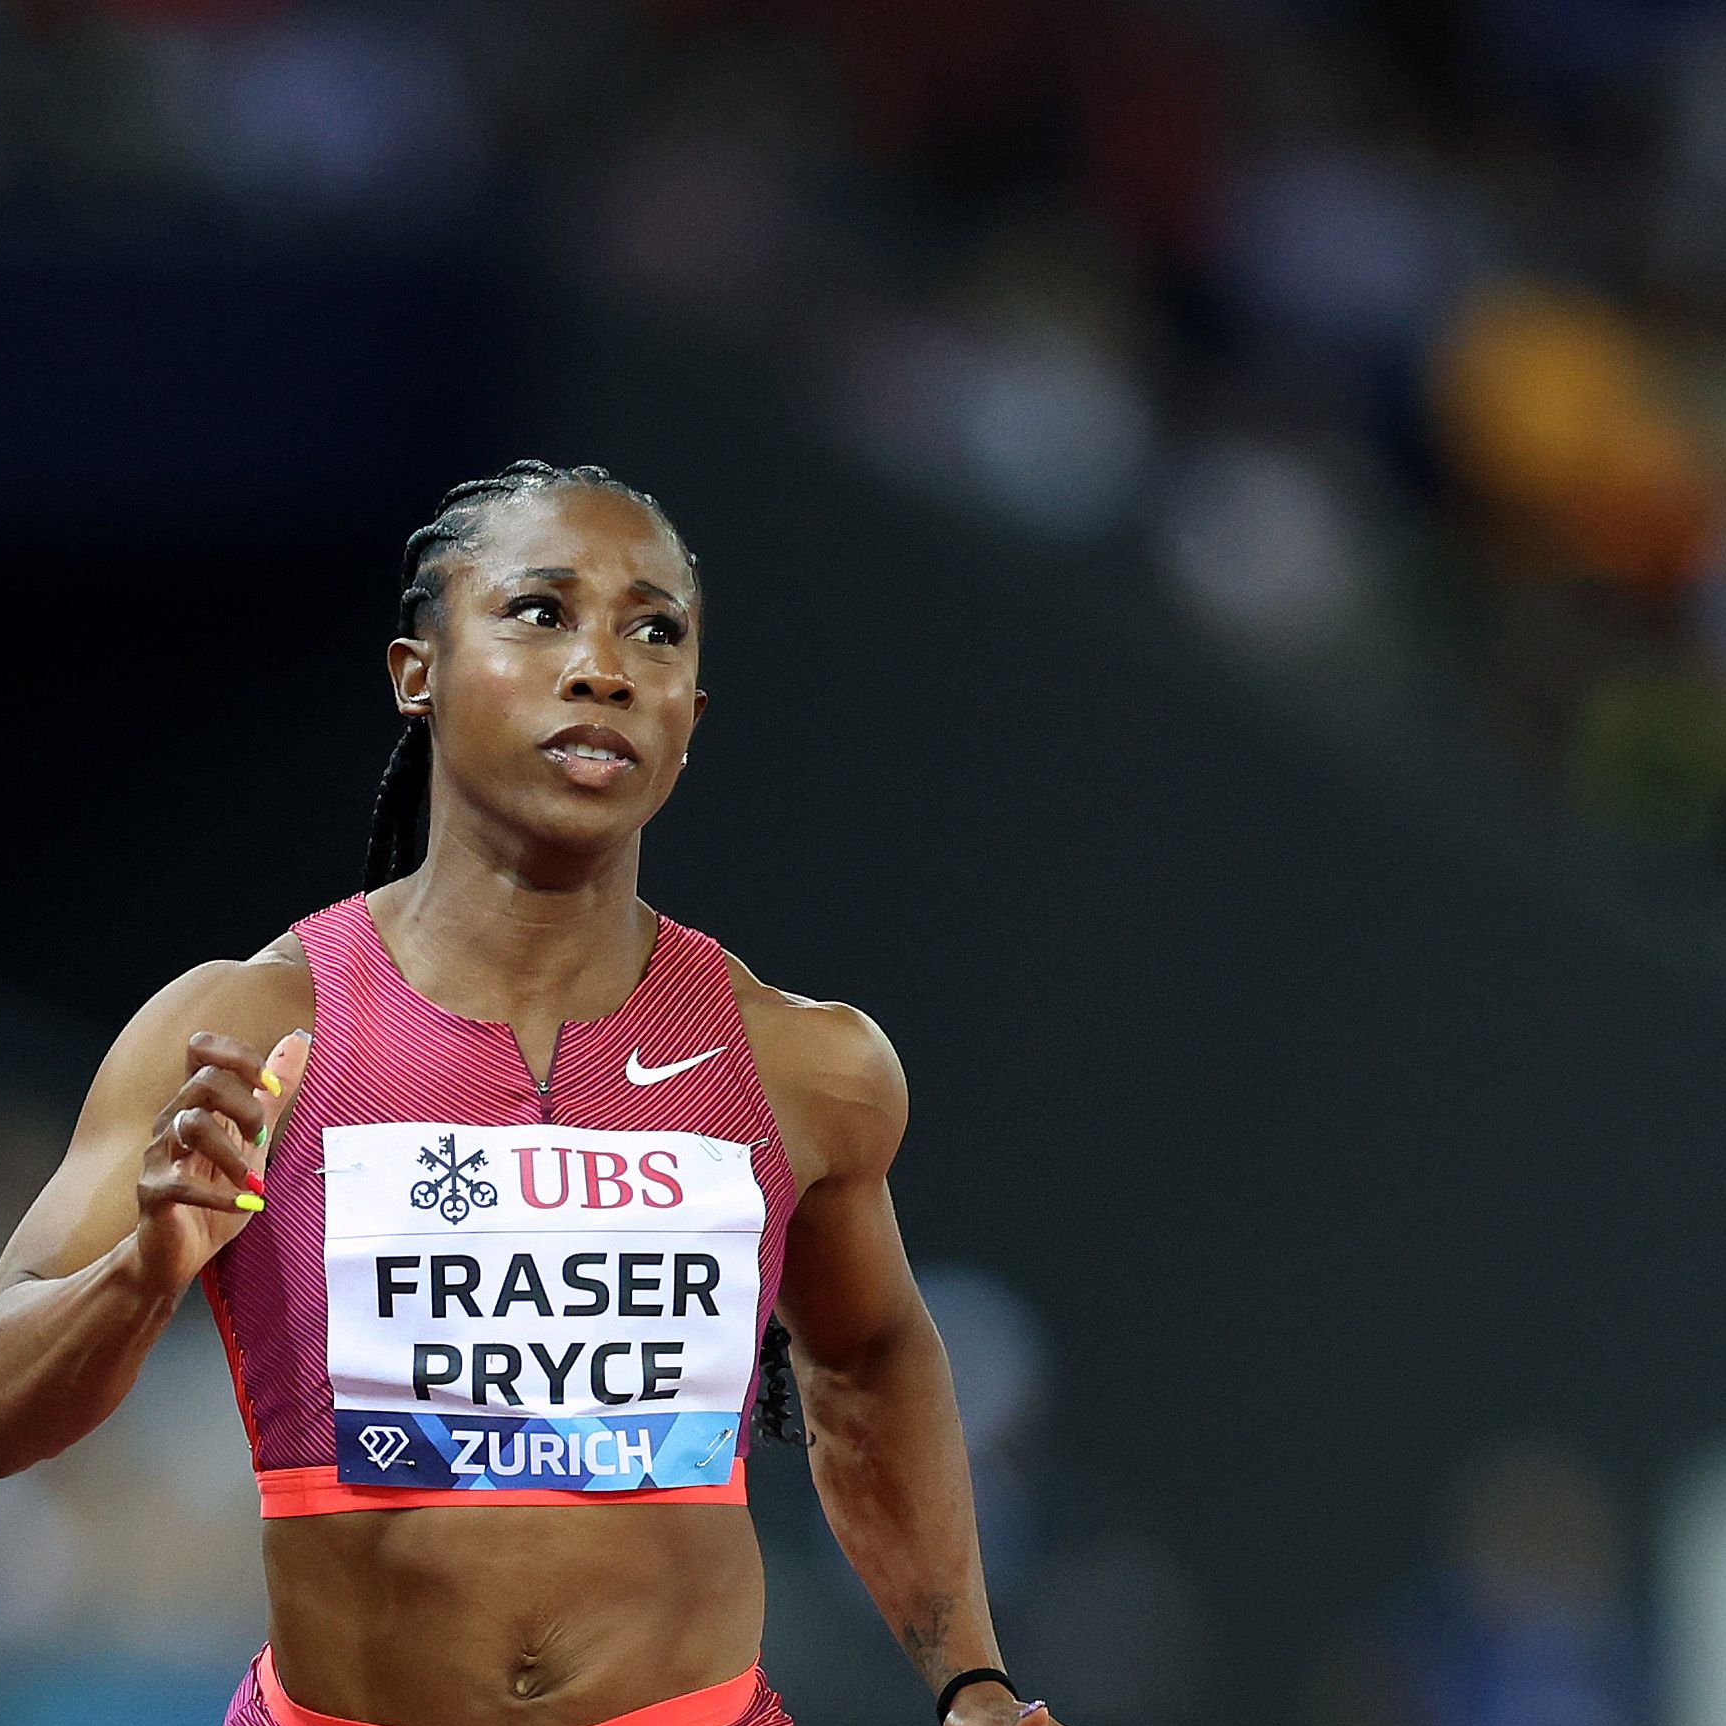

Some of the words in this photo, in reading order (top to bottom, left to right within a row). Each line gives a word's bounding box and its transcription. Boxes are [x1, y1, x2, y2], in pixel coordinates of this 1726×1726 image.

[511, 1147, 684, 1210] UBS
[375, 1253, 721, 1319] FRASER
[413, 1342, 684, 1406] PRYCE
[450, 1429, 654, 1476] ZURICH
